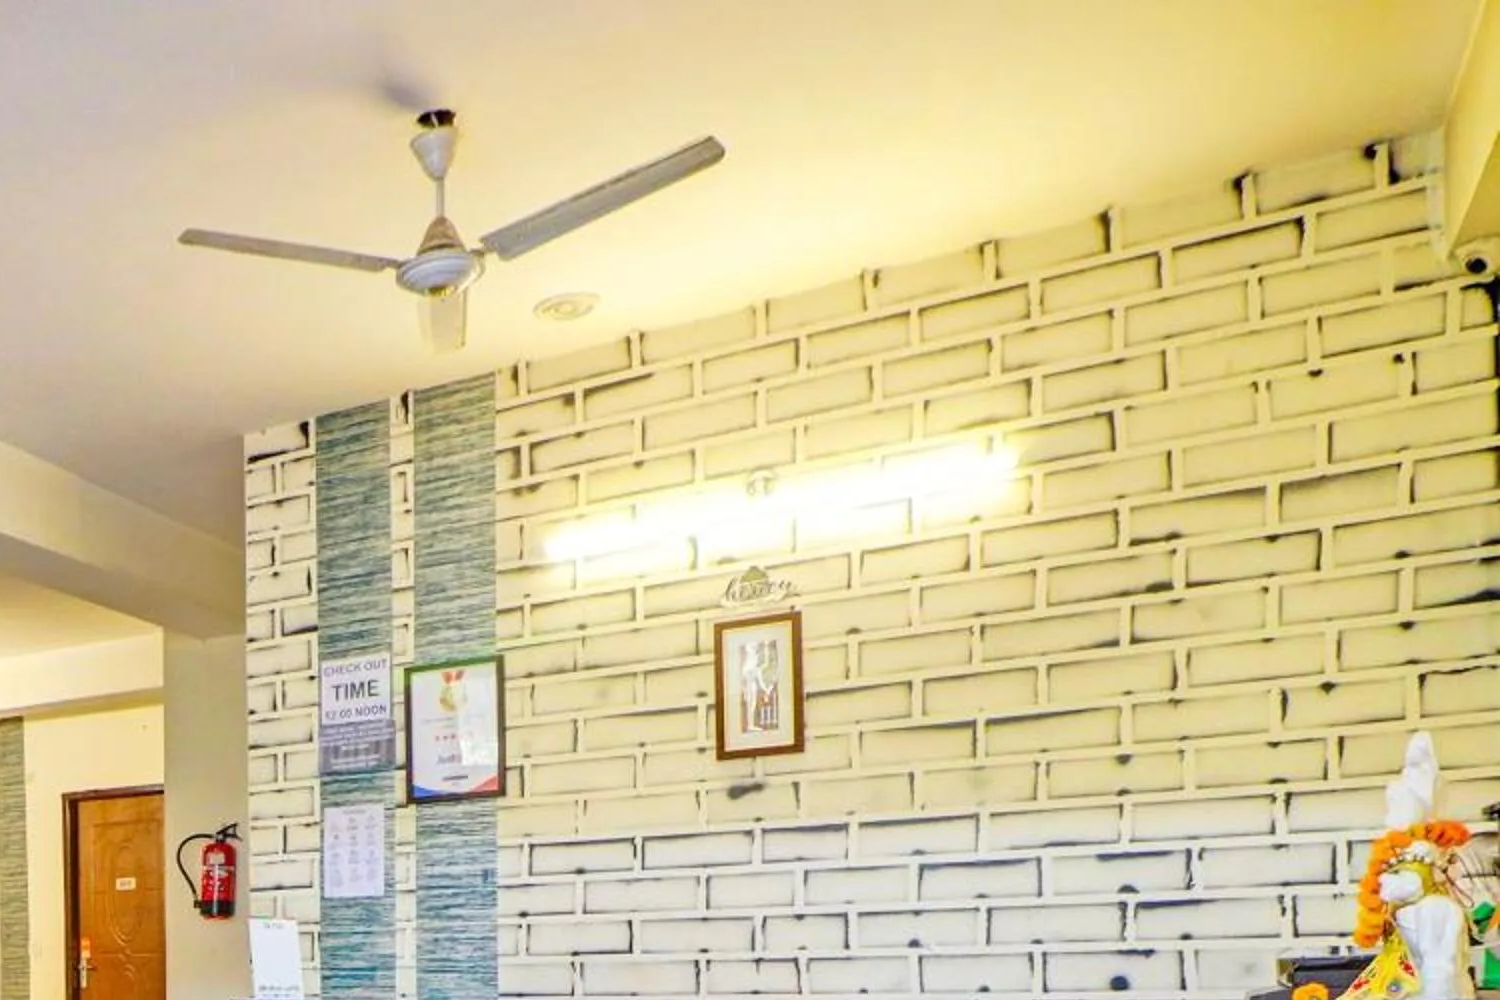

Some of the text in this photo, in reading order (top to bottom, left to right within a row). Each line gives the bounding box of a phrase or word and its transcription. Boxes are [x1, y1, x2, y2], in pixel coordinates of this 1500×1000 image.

[323, 659, 387, 677] CHECK OUT
[331, 679, 381, 702] TIME
[355, 703, 387, 717] NOON
